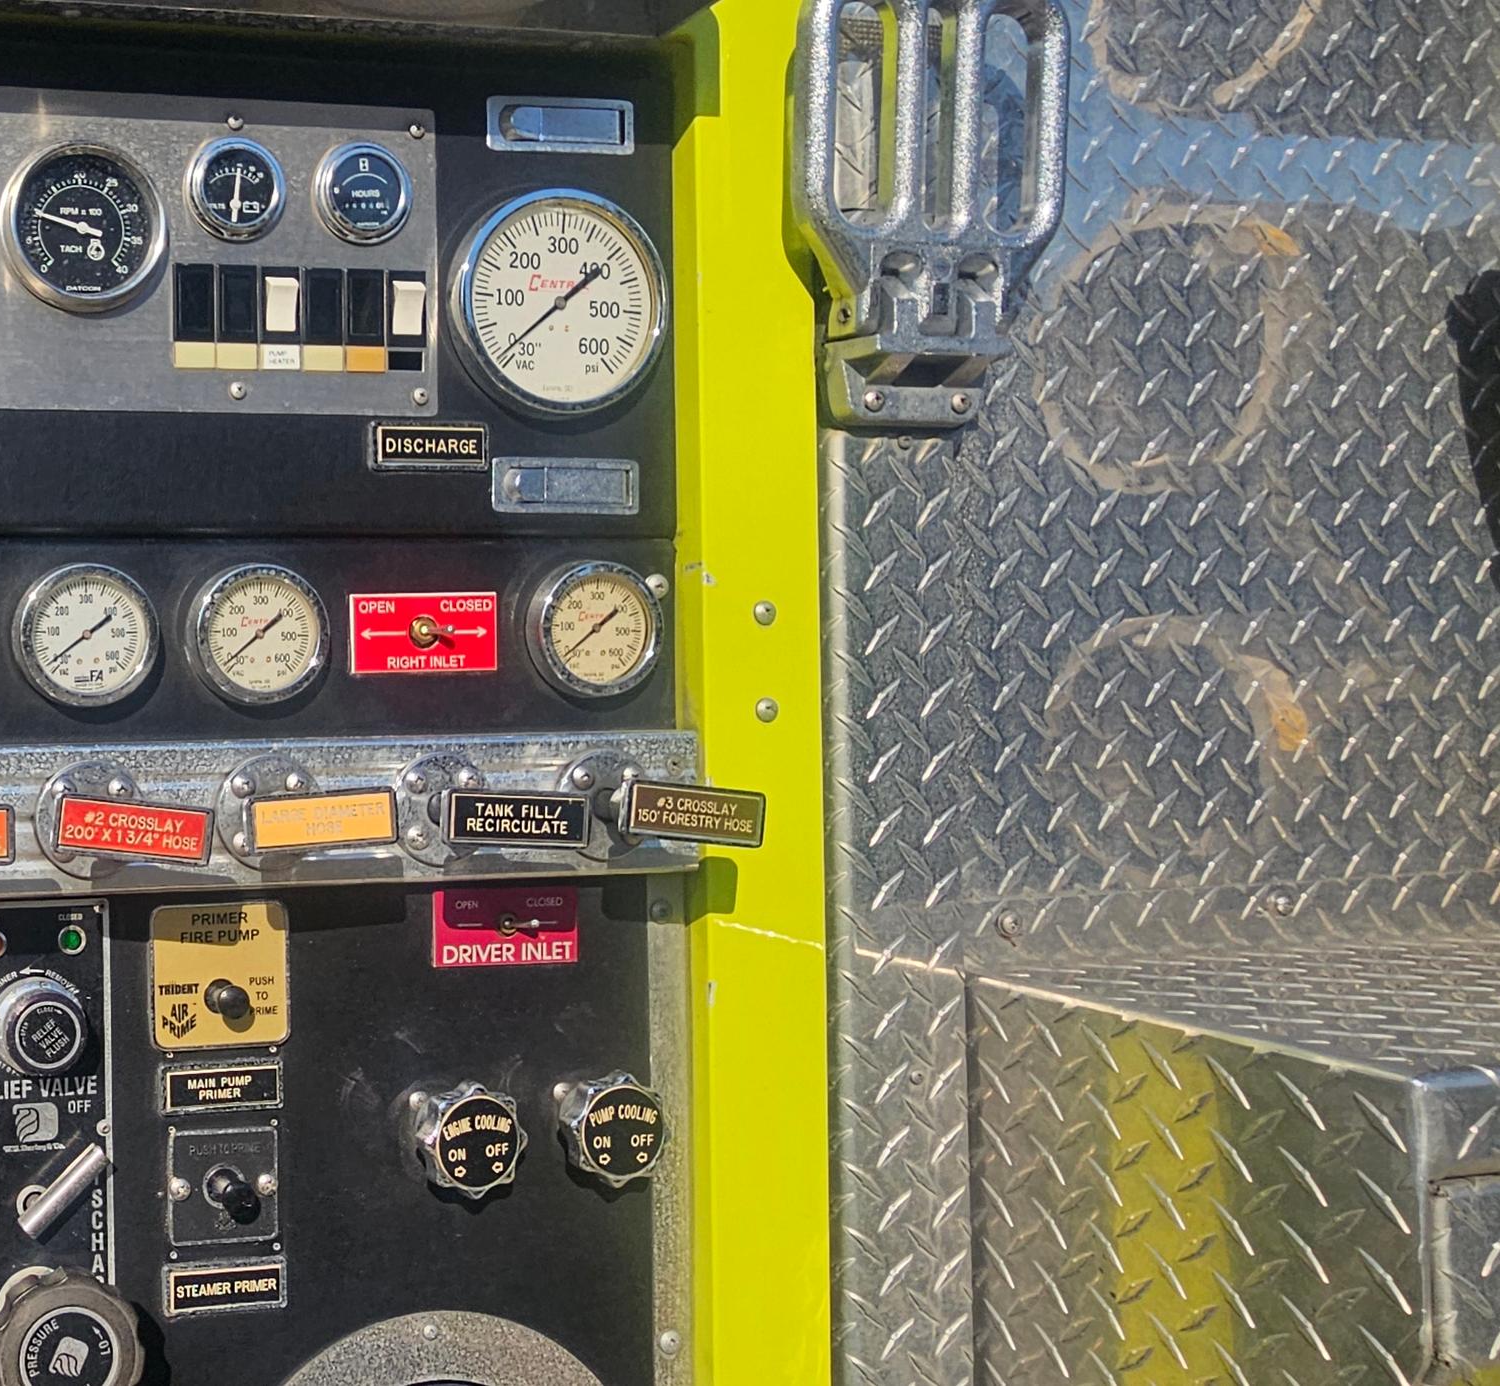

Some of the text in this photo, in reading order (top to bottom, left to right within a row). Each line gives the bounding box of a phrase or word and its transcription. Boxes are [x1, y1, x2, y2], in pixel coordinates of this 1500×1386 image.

[106, 178, 118, 186] 25
[89, 208, 102, 216] 100
[60, 245, 82, 253] TACH
[548, 237, 579, 254] 300
[509, 252, 540, 270] 200
[116, 265, 128, 274] 40
[496, 289, 524, 306] 100
[589, 302, 620, 318] 500
[579, 338, 609, 355] 600
[515, 361, 534, 370] VAC
[585, 363, 599, 374] psi
[386, 438, 477, 454] DISCHARGE
[79, 595, 93, 604] 300
[253, 596, 268, 605] 300
[590, 592, 604, 600] 300
[359, 600, 492, 613] OPEN CLOSED
[111, 629, 125, 638] 500
[387, 655, 465, 668] RIGHT INLET
[261, 802, 385, 824] LARGE DIAMETER
[476, 803, 562, 819] TANK FILL/
[657, 797, 738, 815] #3 CROSSLAY
[84, 812, 184, 832] #2 CROSSLAY
[306, 821, 343, 836] HOSE
[467, 818, 568, 835] RECIRCULATE
[638, 809, 752, 833] 150' FORESTRY HOSE
[65, 825, 99, 840] 200'
[101, 829, 111, 841] X
[162, 836, 197, 851] HOSE
[455, 897, 563, 909] OPEN CLOSED
[192, 912, 247, 925] PRIMER
[180, 929, 259, 943] FIRE PUMP
[443, 942, 572, 964] DRIVER INLET
[159, 983, 199, 995] TRIDENT
[249, 977, 274, 985] PUSH
[256, 991, 268, 1000] TO
[171, 1004, 188, 1023] AIR
[31, 1019, 56, 1042] RELIEF
[162, 1014, 196, 1039] PRIME
[40, 1028, 63, 1049] VALVE
[45, 1036, 70, 1058] FLUSH
[39, 1076, 97, 1098] VALVE
[188, 1076, 252, 1089] MAIN PUMP
[199, 1088, 240, 1100] PRIMER
[68, 1099, 92, 1113] OFF
[589, 1105, 658, 1127] PUMP COOLING
[443, 1115, 512, 1141] ENGINE COOLING
[593, 1135, 654, 1148] ON OFF
[189, 1145, 220, 1156] PUSH
[449, 1143, 508, 1161] ON OFF
[176, 1278, 277, 1298] STEAMER PRIMER
[27, 1319, 59, 1377] PRESSURE
